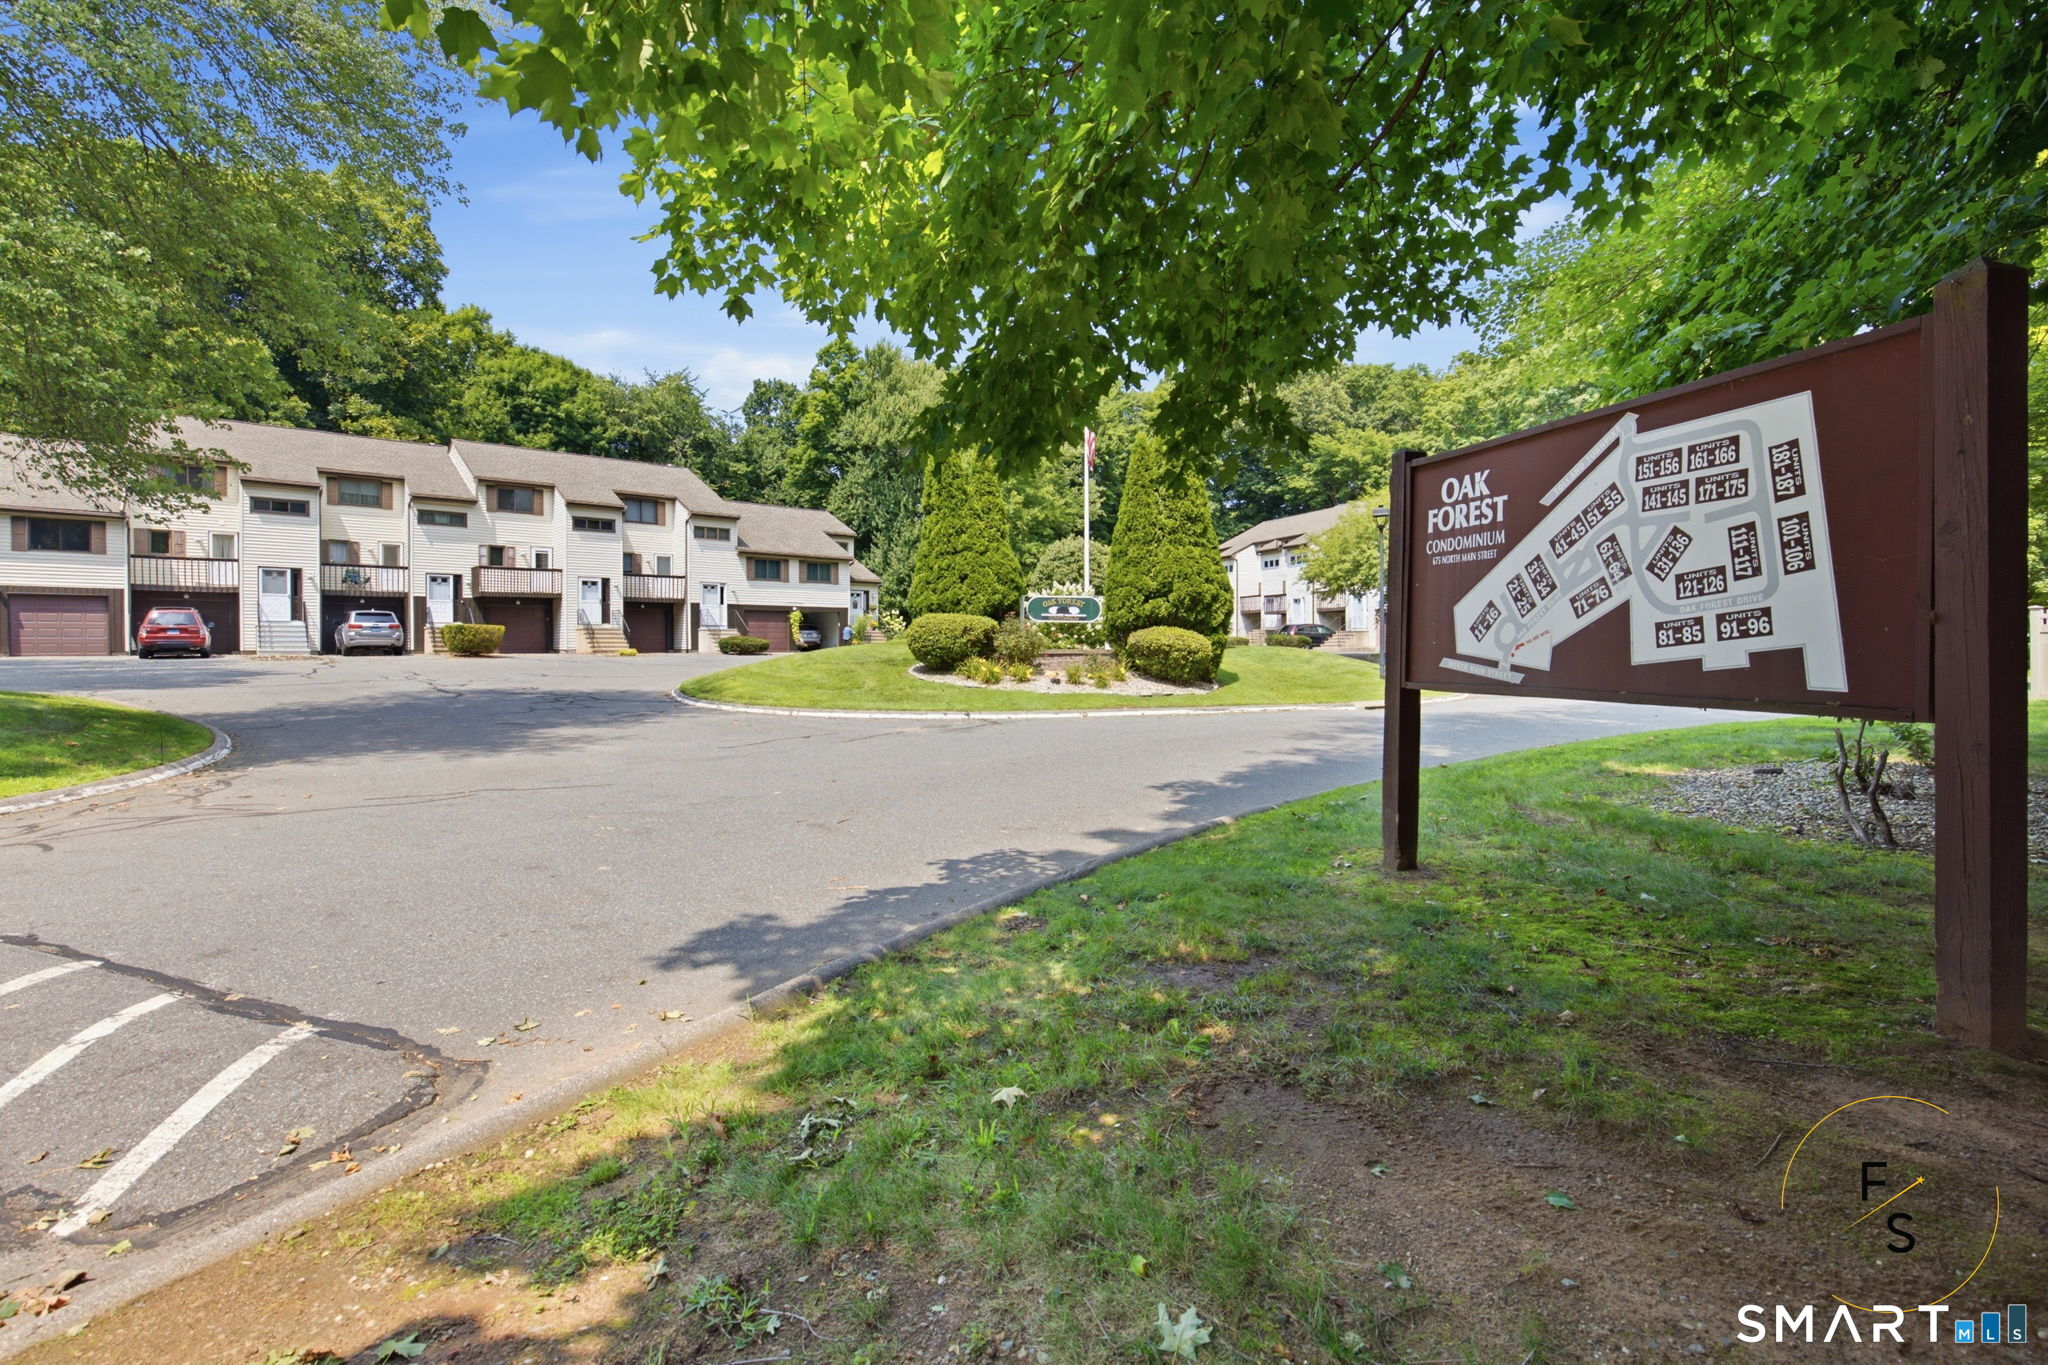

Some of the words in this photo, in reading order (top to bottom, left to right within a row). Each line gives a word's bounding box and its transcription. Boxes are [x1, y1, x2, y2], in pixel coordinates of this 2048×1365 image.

[1643, 451, 1674, 463] UNITS
[1689, 445, 1736, 470] 161-166
[1696, 439, 1730, 451] UNITS
[1637, 457, 1680, 481] 151-156
[1704, 472, 1739, 484] UNITS
[1771, 444, 1795, 496] 181-187
[1791, 448, 1802, 486] UNITS
[1441, 469, 1490, 504] OAK
[1650, 482, 1680, 493] UNITS
[1698, 478, 1746, 502] 171-175
[1586, 489, 1622, 526] 51-55
[1587, 489, 1611, 512] UNITS
[1644, 489, 1687, 511] 141-145
[1427, 495, 1508, 534] FOREST
[1426, 529, 1505, 554] CONDOMINIUM
[1554, 521, 1576, 541] UNITS
[1555, 521, 1586, 555] 41-45
[1801, 522, 1812, 560] UNITS
[1652, 534, 1674, 564] UNITS
[1653, 533, 1690, 579] 131-136
[1730, 527, 1753, 576] 111-117
[1749, 531, 1759, 567] UNITS
[1781, 517, 1806, 571] 101-106
[1442, 554, 1460, 565] NORTH
[1461, 552, 1477, 562] MAIN
[1477, 549, 1497, 560] STREET
[1600, 541, 1625, 582] 61-64
[1527, 560, 1551, 597] 31-34
[1678, 574, 1725, 598] 121-126
[1683, 568, 1717, 580] UNITS
[1507, 579, 1531, 614] 21-25
[1573, 585, 1609, 615] 71-76
[1680, 605, 1697, 613] OAK
[1701, 599, 1733, 610] FOREST
[1736, 593, 1764, 605] DRIVE
[1474, 607, 1499, 640] 11-16
[1663, 619, 1695, 629] UNITS
[1725, 609, 1762, 621] UNITS
[1658, 625, 1702, 646] 81-85
[1720, 617, 1770, 641] 91-96
